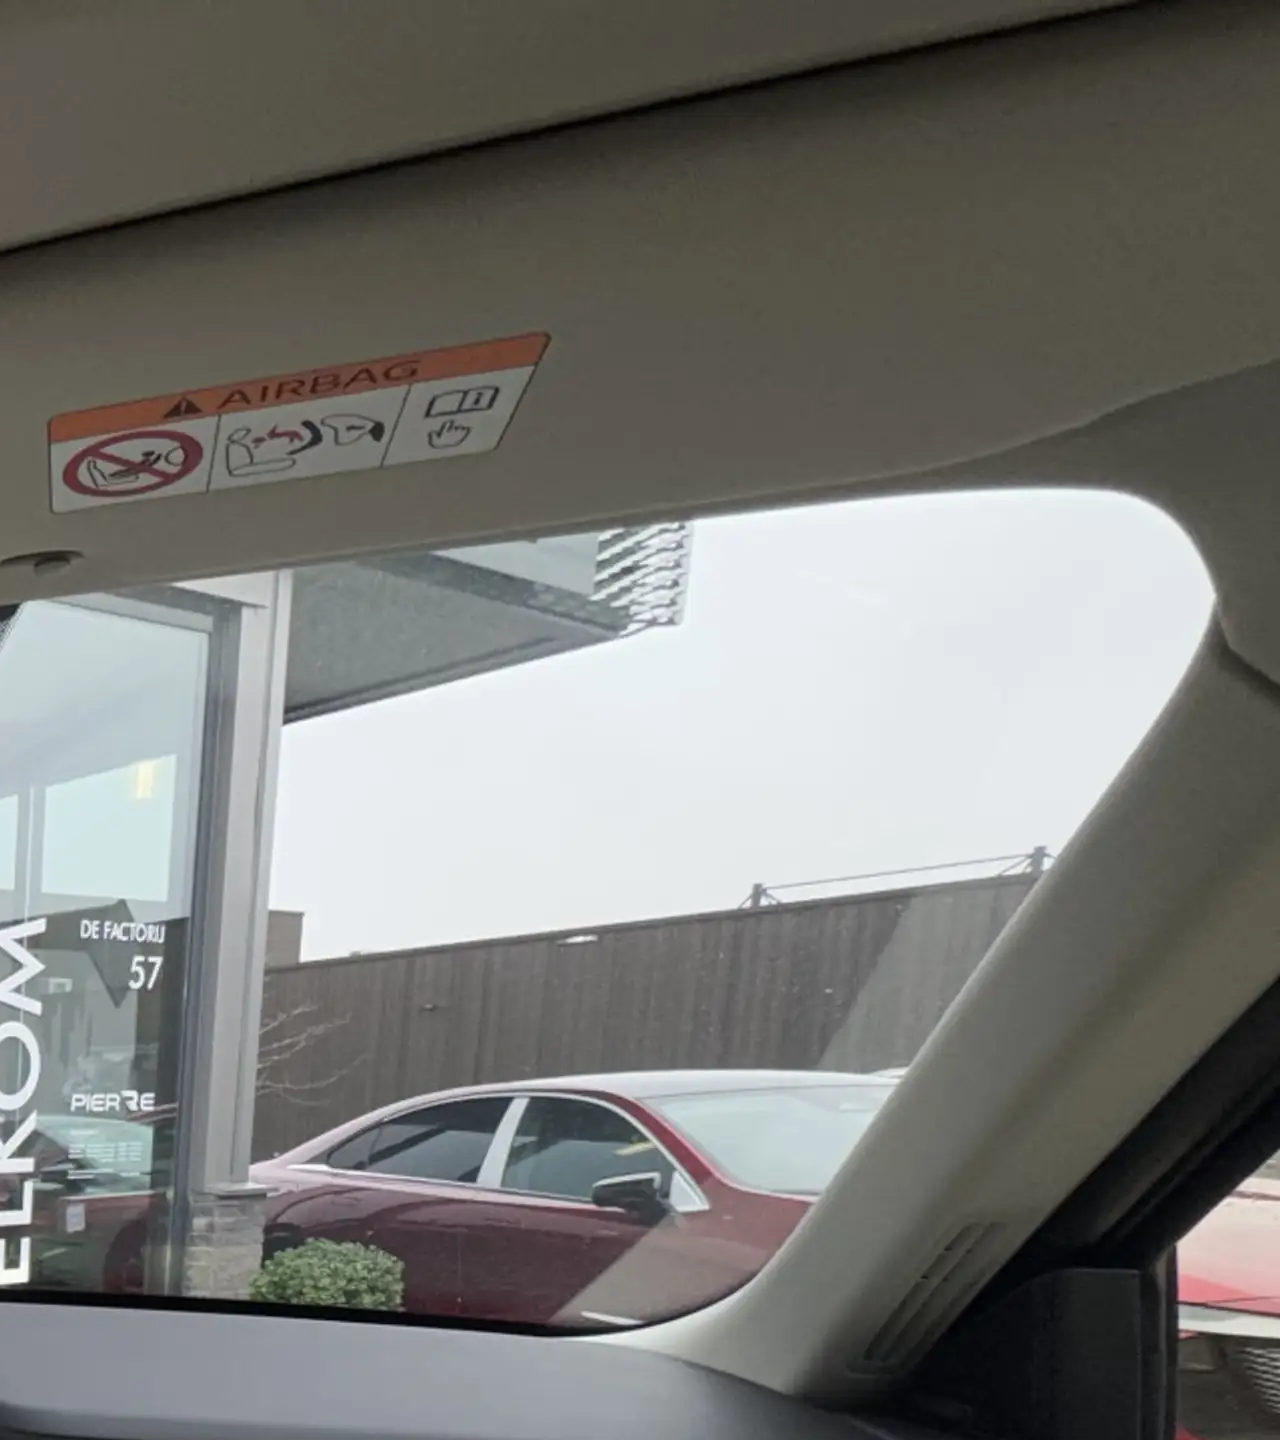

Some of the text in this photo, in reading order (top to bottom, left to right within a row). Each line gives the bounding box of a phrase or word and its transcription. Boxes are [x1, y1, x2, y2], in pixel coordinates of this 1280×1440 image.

[216, 359, 421, 410] AIRBAG
[80, 918, 166, 944] DE FACTORIJ
[127, 954, 164, 990] 57
[70, 1090, 156, 1113] PIERRE
